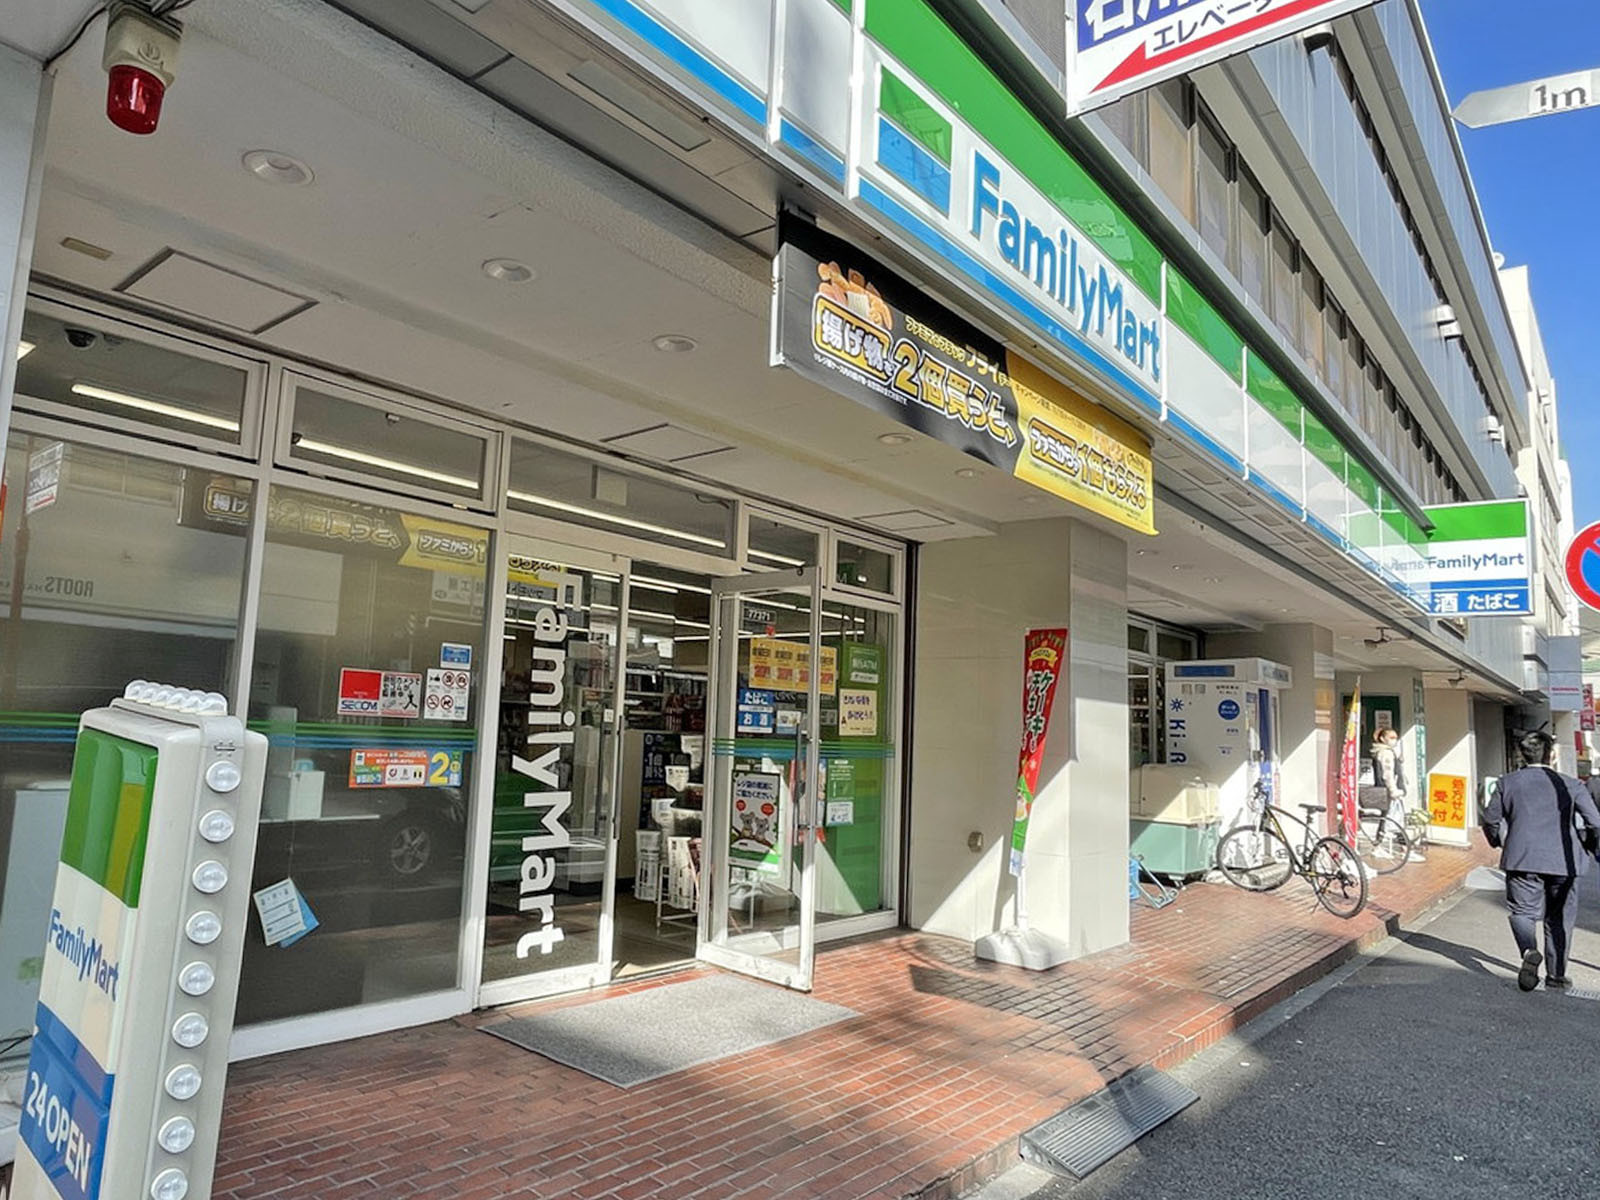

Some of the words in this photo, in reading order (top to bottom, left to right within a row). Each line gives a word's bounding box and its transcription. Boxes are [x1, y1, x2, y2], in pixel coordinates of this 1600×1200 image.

[969, 149, 1160, 384] FamilyMart
[1428, 552, 1525, 572] FamilyMart
[1467, 593, 1521, 611] たばこ
[341, 700, 378, 711] SECOM
[511, 572, 583, 959] FamilyMart
[1433, 790, 1448, 822] 受付
[1452, 778, 1464, 822] 処方せん
[48, 908, 120, 1002] FamilyMart
